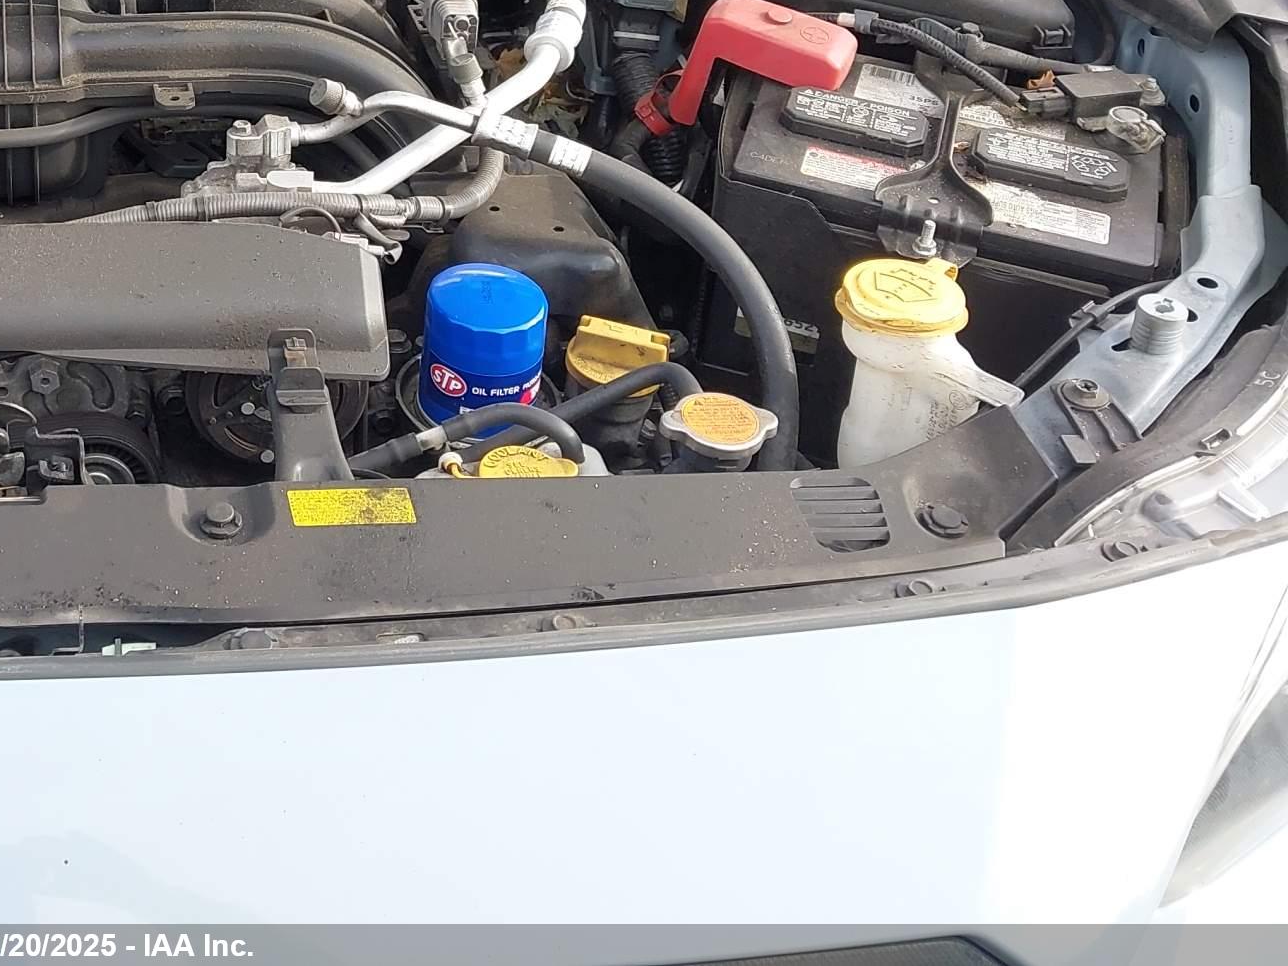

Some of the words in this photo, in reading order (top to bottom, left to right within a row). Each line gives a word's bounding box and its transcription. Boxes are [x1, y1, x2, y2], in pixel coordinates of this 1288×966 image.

[870, 102, 910, 117] POISON
[432, 368, 463, 392] STP
[471, 386, 488, 397] OIL
[489, 385, 520, 397] FILTER
